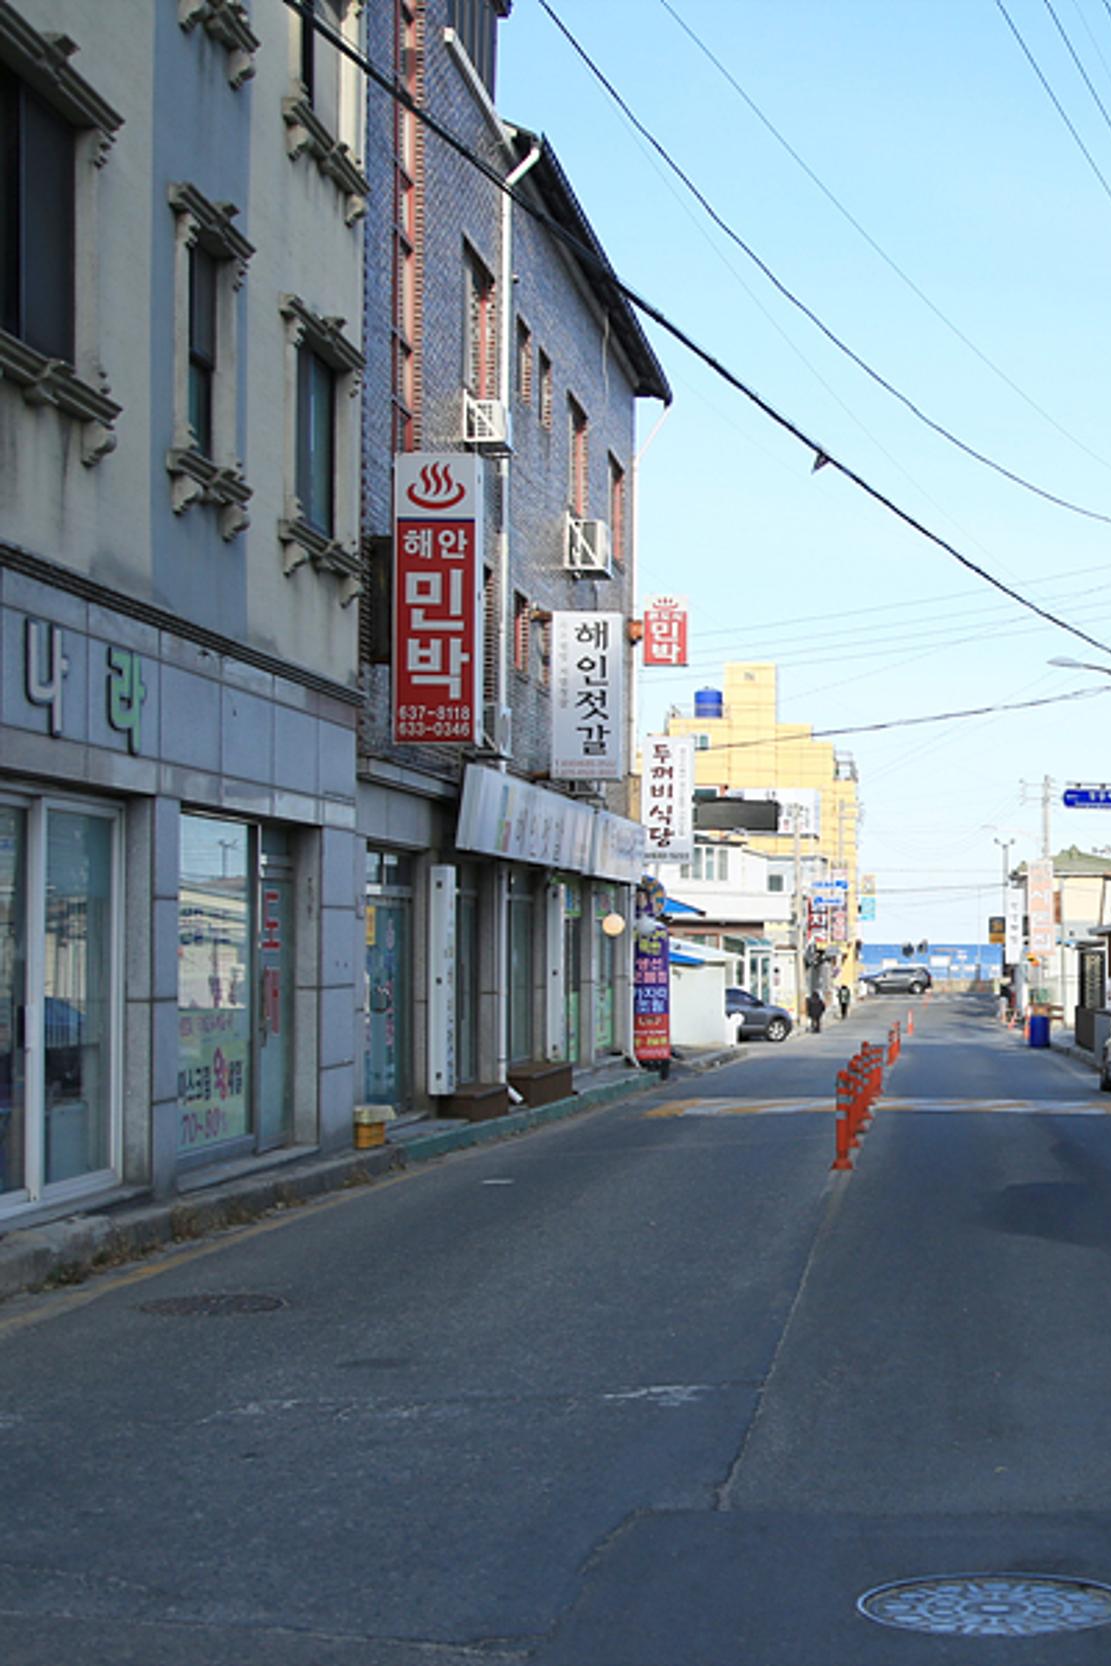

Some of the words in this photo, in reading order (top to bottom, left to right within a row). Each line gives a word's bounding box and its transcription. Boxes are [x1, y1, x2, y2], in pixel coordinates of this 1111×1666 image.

[403, 528, 469, 560] 해안
[405, 568, 470, 700] 민박
[650, 622, 683, 664] 민박
[574, 620, 611, 756] 해인젓갈
[647, 744, 675, 849] 두꺼비식당
